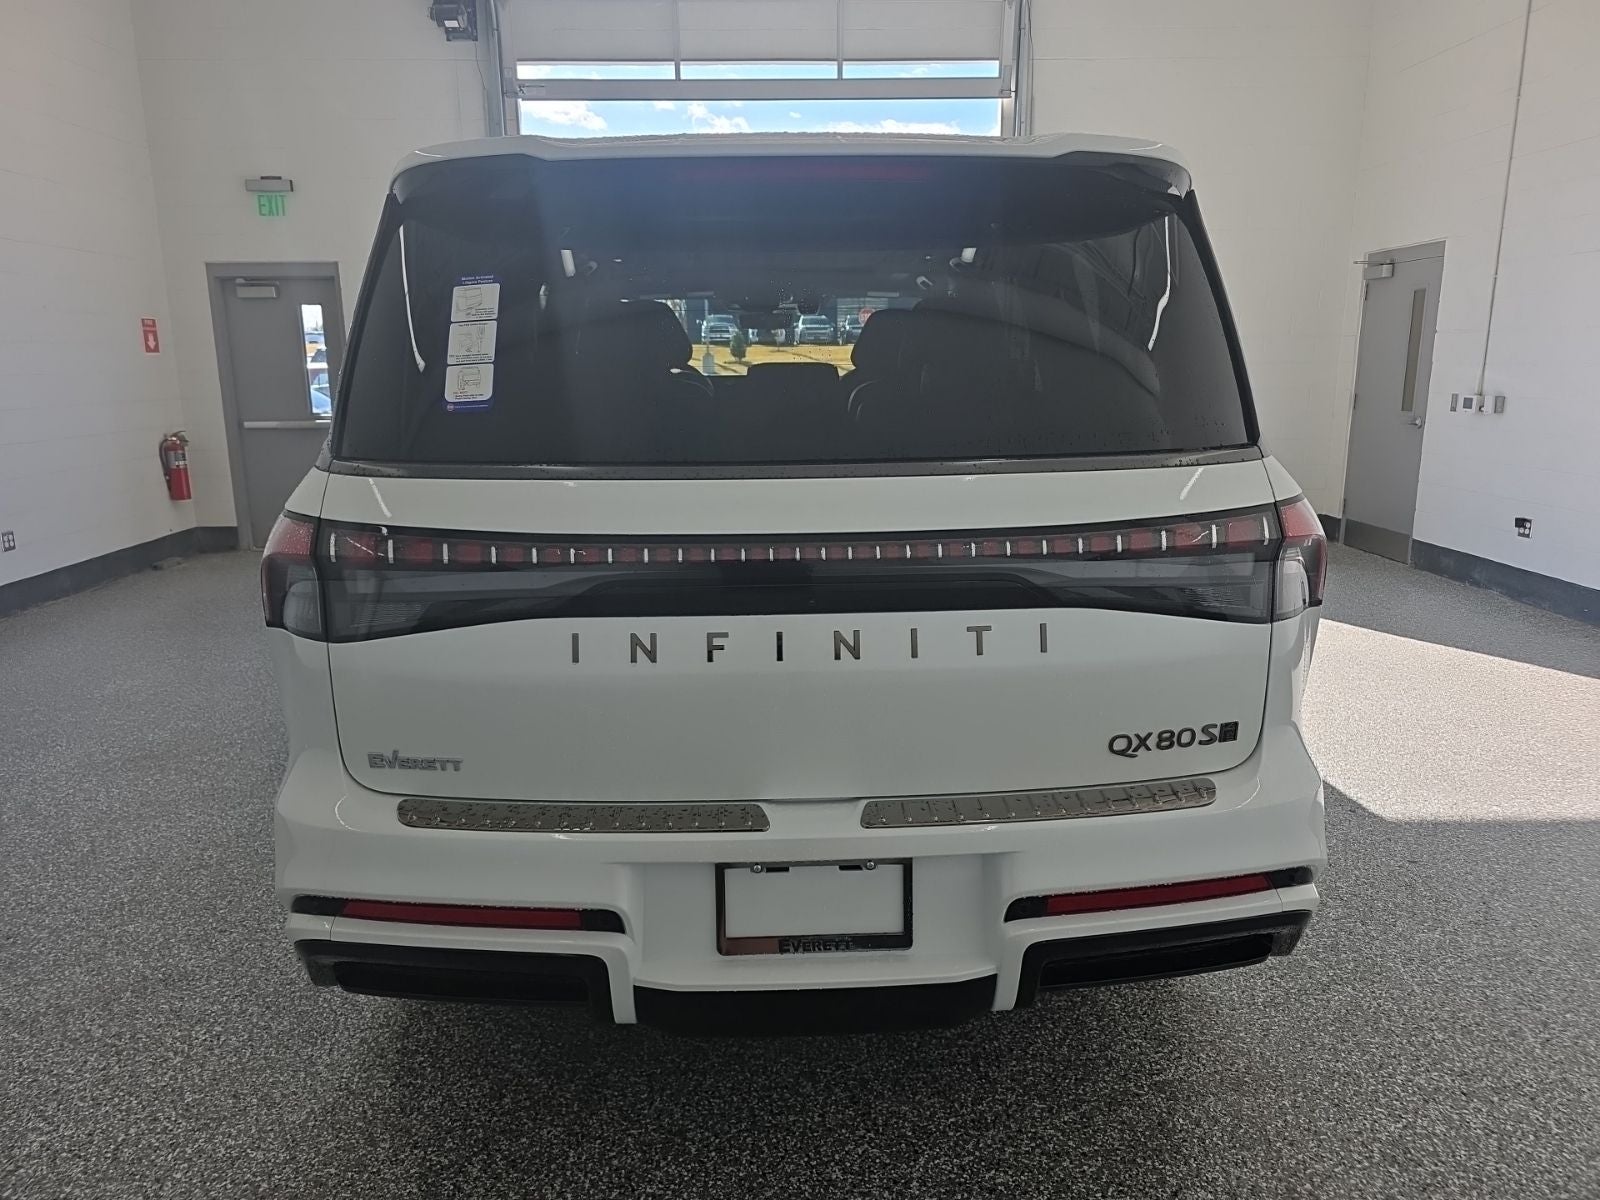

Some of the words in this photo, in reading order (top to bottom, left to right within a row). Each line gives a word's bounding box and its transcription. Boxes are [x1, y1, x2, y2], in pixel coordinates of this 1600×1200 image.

[256, 194, 287, 217] EXIT
[571, 622, 1048, 664] INFINITI
[367, 749, 464, 772] EVERETT
